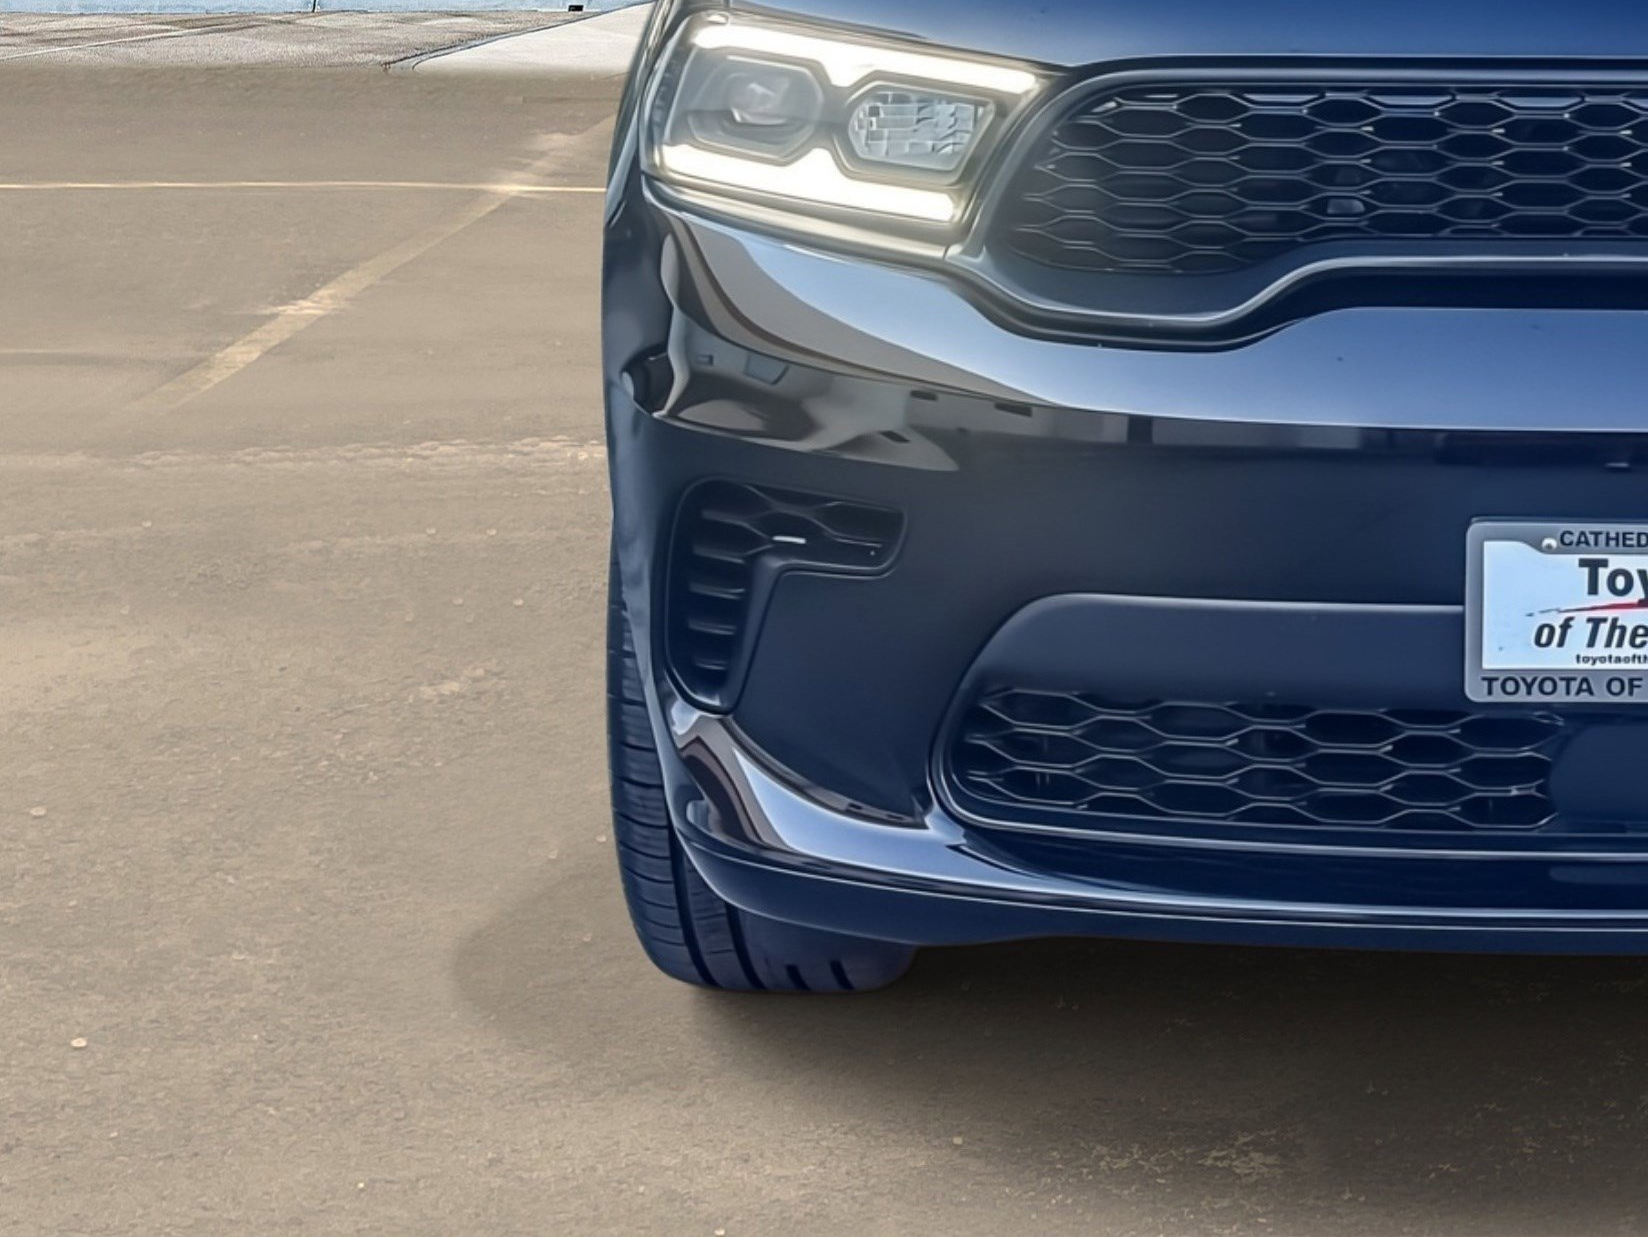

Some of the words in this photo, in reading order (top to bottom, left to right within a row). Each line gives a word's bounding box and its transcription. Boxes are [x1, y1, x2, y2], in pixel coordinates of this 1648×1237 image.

[1533, 616, 1575, 648] of
[1482, 676, 1594, 697] TOYOTA
[1606, 677, 1642, 697] OF
